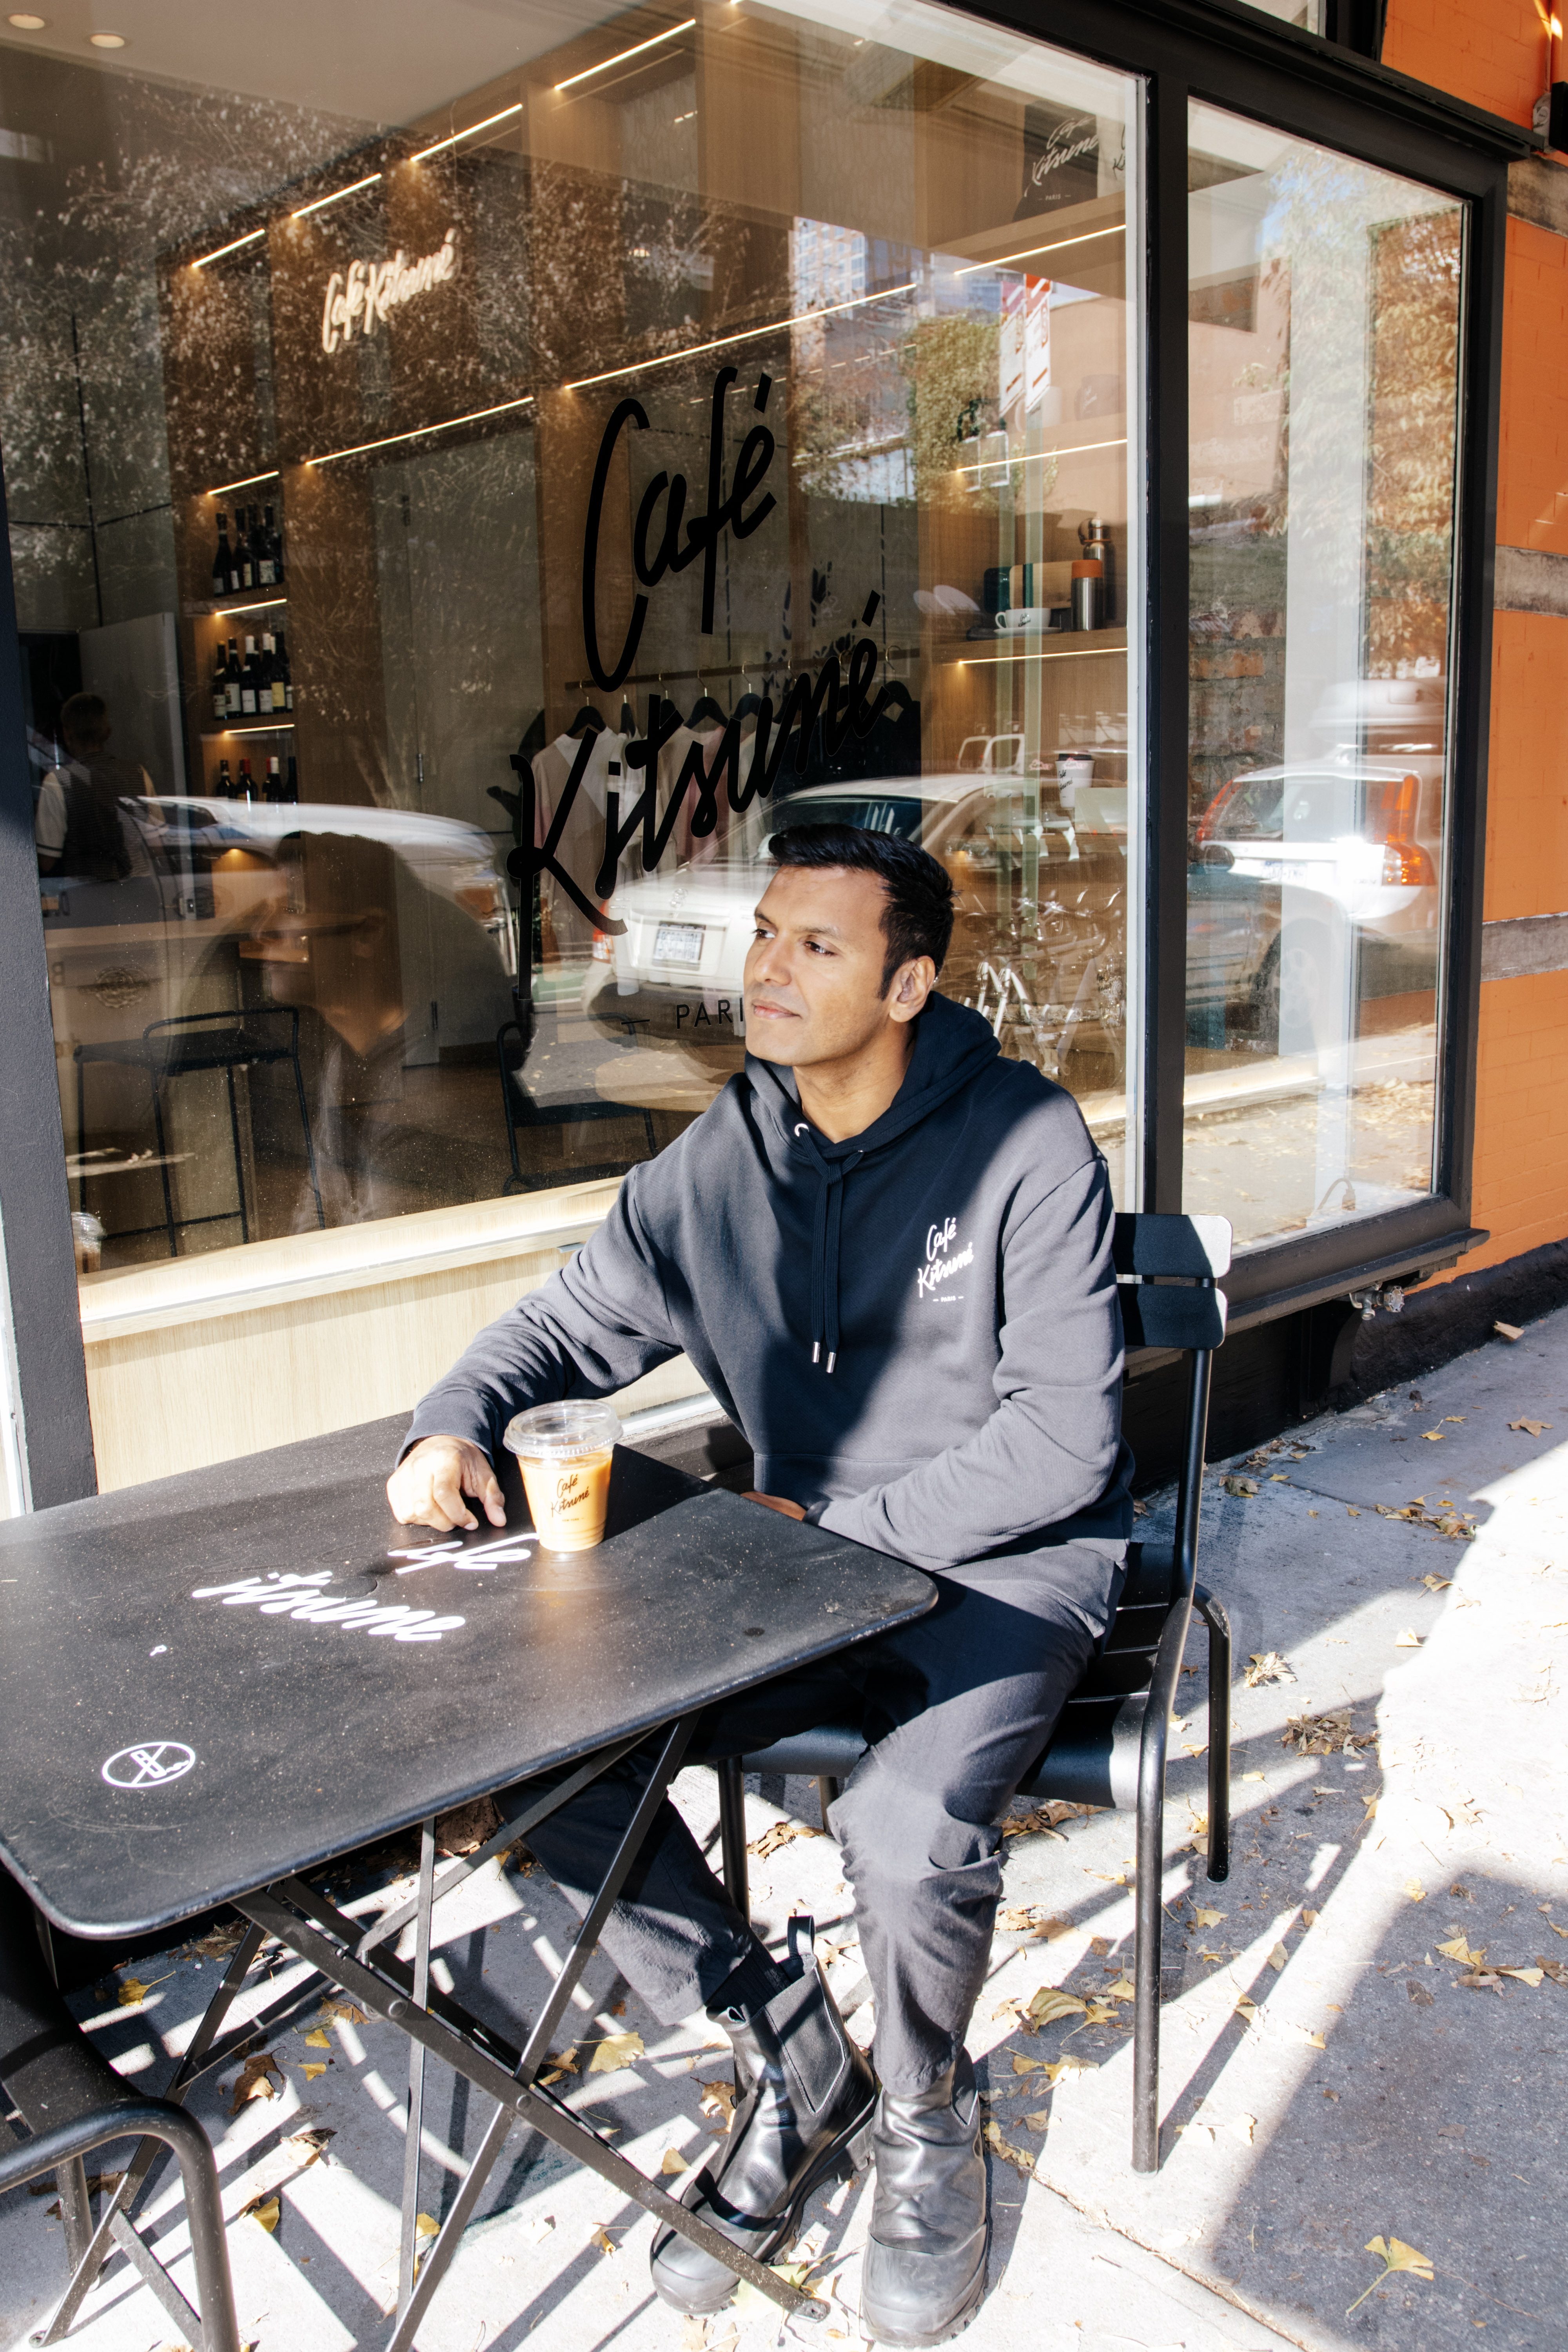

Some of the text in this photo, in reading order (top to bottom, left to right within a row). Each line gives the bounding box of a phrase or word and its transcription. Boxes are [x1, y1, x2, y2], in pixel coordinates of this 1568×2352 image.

[322, 227, 457, 354] Café Kitsuné
[583, 365, 777, 693] Café
[506, 589, 890, 1000] Kitsuné
[677, 998, 744, 1029] PARI
[926, 1217, 956, 1261] Café
[918, 1242, 974, 1298] Kitsuné
[551, 1486, 590, 1518] Kitsuné
[557, 1474, 578, 1498] Café
